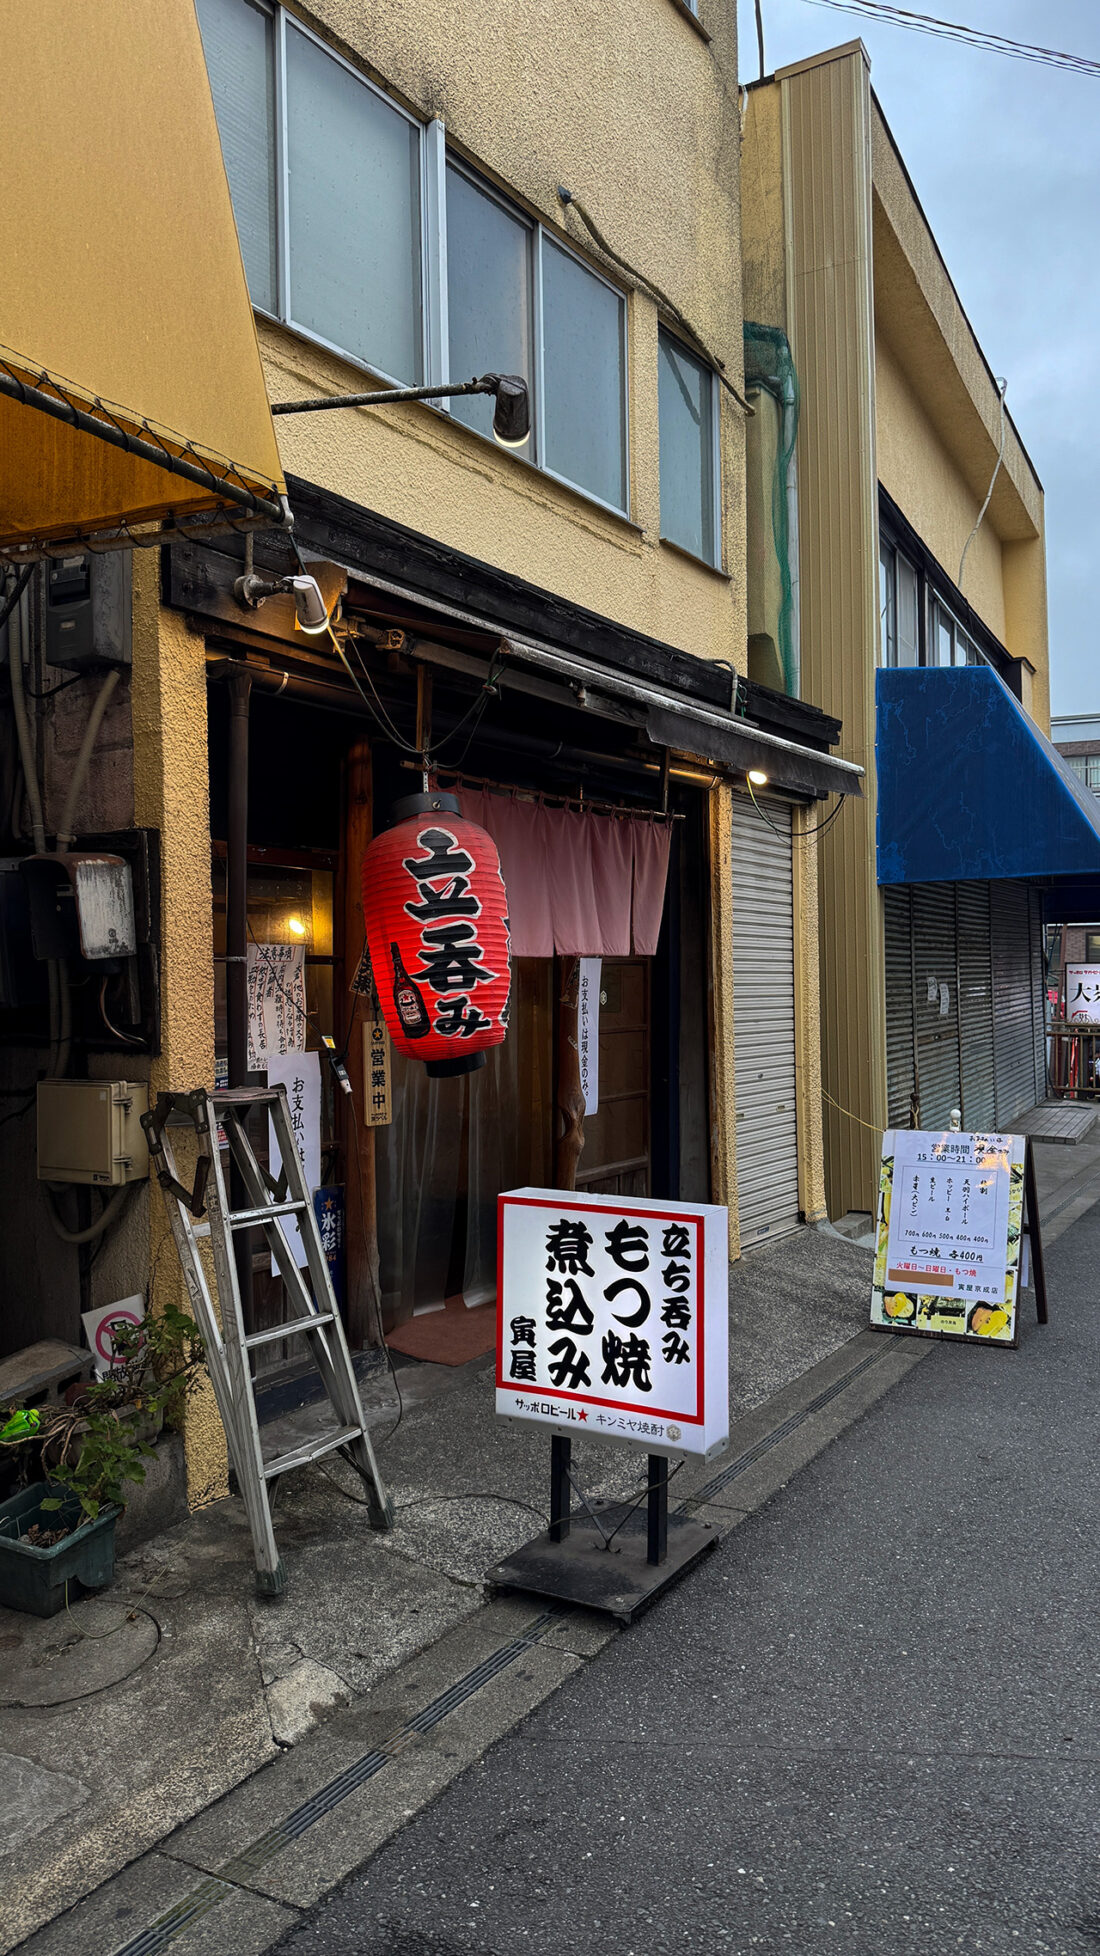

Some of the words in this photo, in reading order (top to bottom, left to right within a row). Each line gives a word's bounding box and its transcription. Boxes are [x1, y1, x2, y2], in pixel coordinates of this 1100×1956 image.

[403, 827, 498, 1038] 立呑み
[371, 1048, 386, 1109] 営業中
[931, 1143, 970, 1154] 営業時間
[321, 1212, 337, 1251] 氷彩
[909, 1245, 941, 1258] もつ焼
[948, 1249, 984, 1262] 各400円
[545, 1218, 596, 1390] 煮込み
[600, 1218, 653, 1392] もつ焼
[660, 1222, 692, 1365] 立ち呑み
[509, 1315, 538, 1382] 寅屋
[514, 1398, 577, 1420] サッポロビール
[595, 1413, 665, 1437] キンミヤ焼酎
